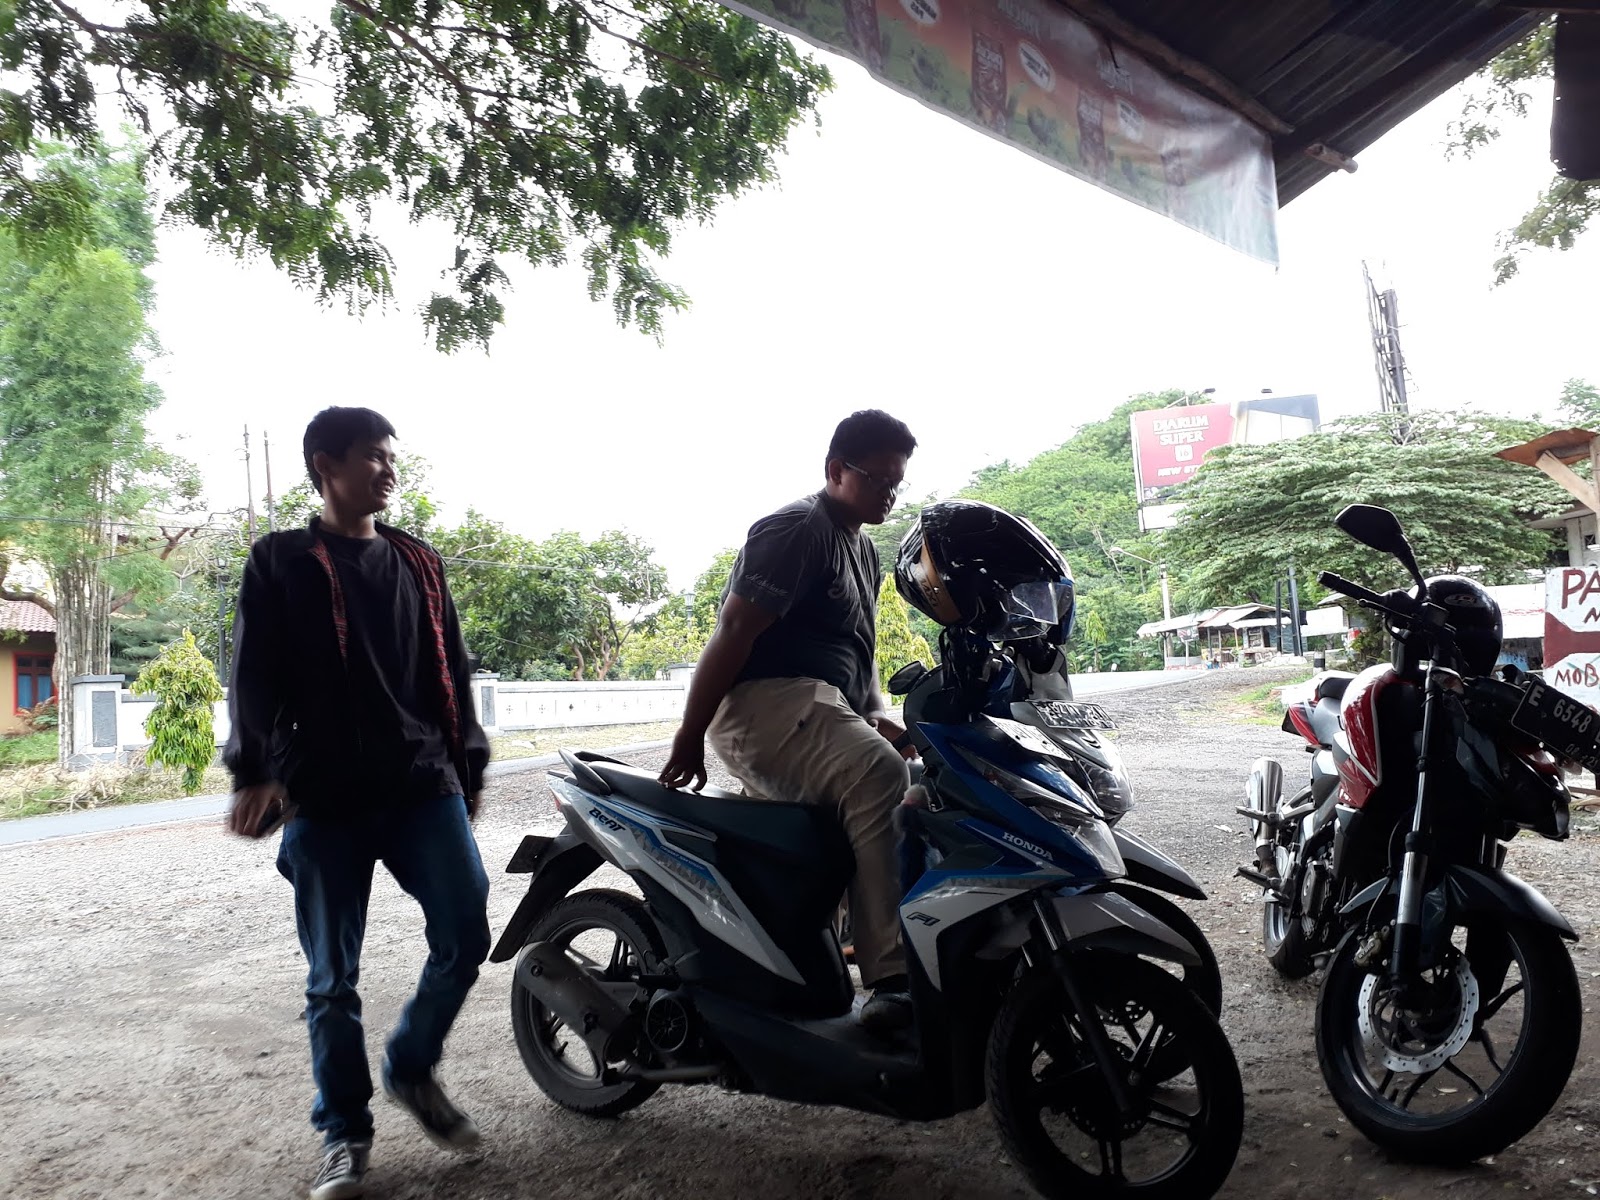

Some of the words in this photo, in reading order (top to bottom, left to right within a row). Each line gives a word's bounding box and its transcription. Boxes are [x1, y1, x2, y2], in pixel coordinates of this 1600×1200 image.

[1153, 415, 1209, 432] DJARUM
[1160, 430, 1205, 445] SUPER
[1528, 684, 1545, 707] E
[1553, 698, 1592, 733] 6548
[1002, 831, 1054, 861] HONDA
